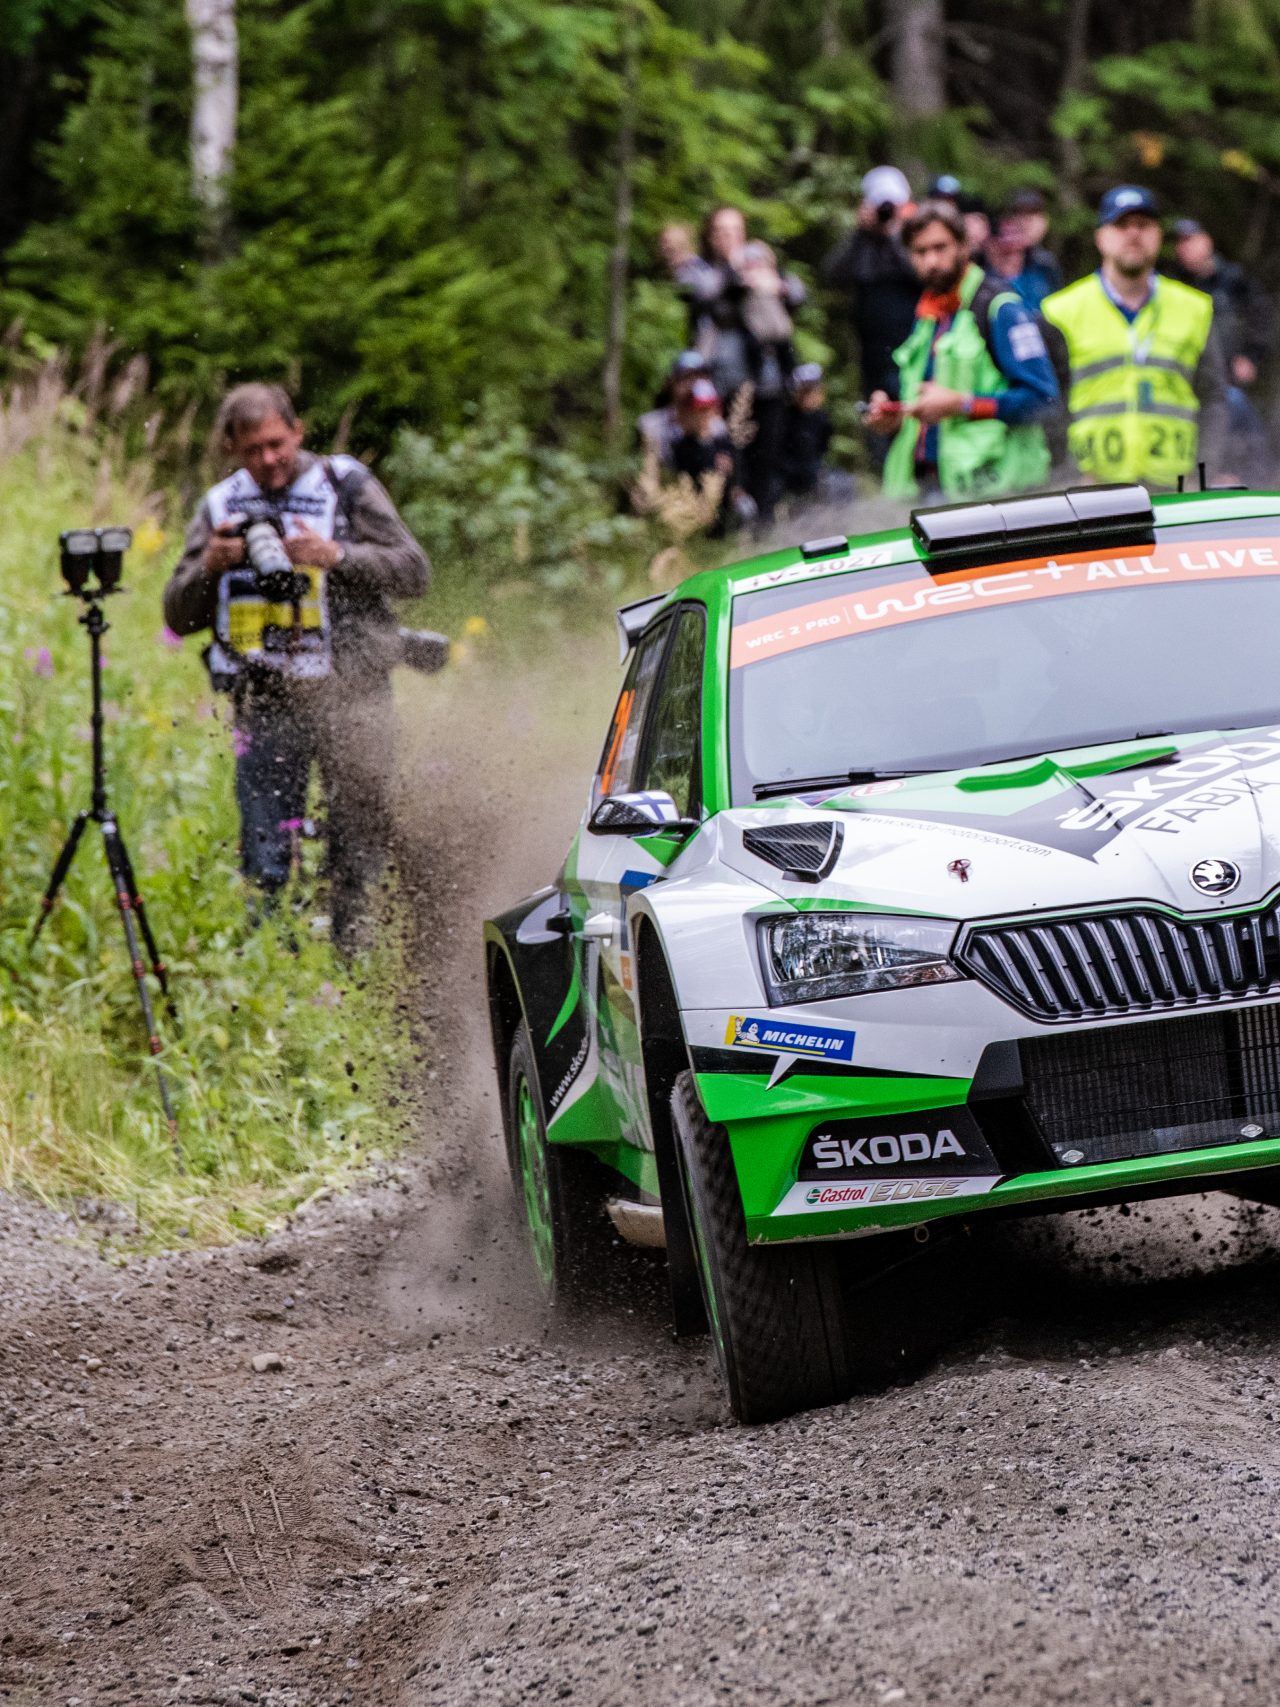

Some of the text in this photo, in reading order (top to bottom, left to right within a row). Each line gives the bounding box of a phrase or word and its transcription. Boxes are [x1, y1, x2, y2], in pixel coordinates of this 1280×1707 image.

[1087, 556, 1170, 581] ALL
[1178, 548, 1279, 571] LIVE
[746, 614, 842, 649] WRC 2 PRO
[762, 1030, 845, 1051] MICHELIN
[812, 1129, 967, 1169] ŠKODA
[819, 1178, 969, 1203] Castrol EDGE
